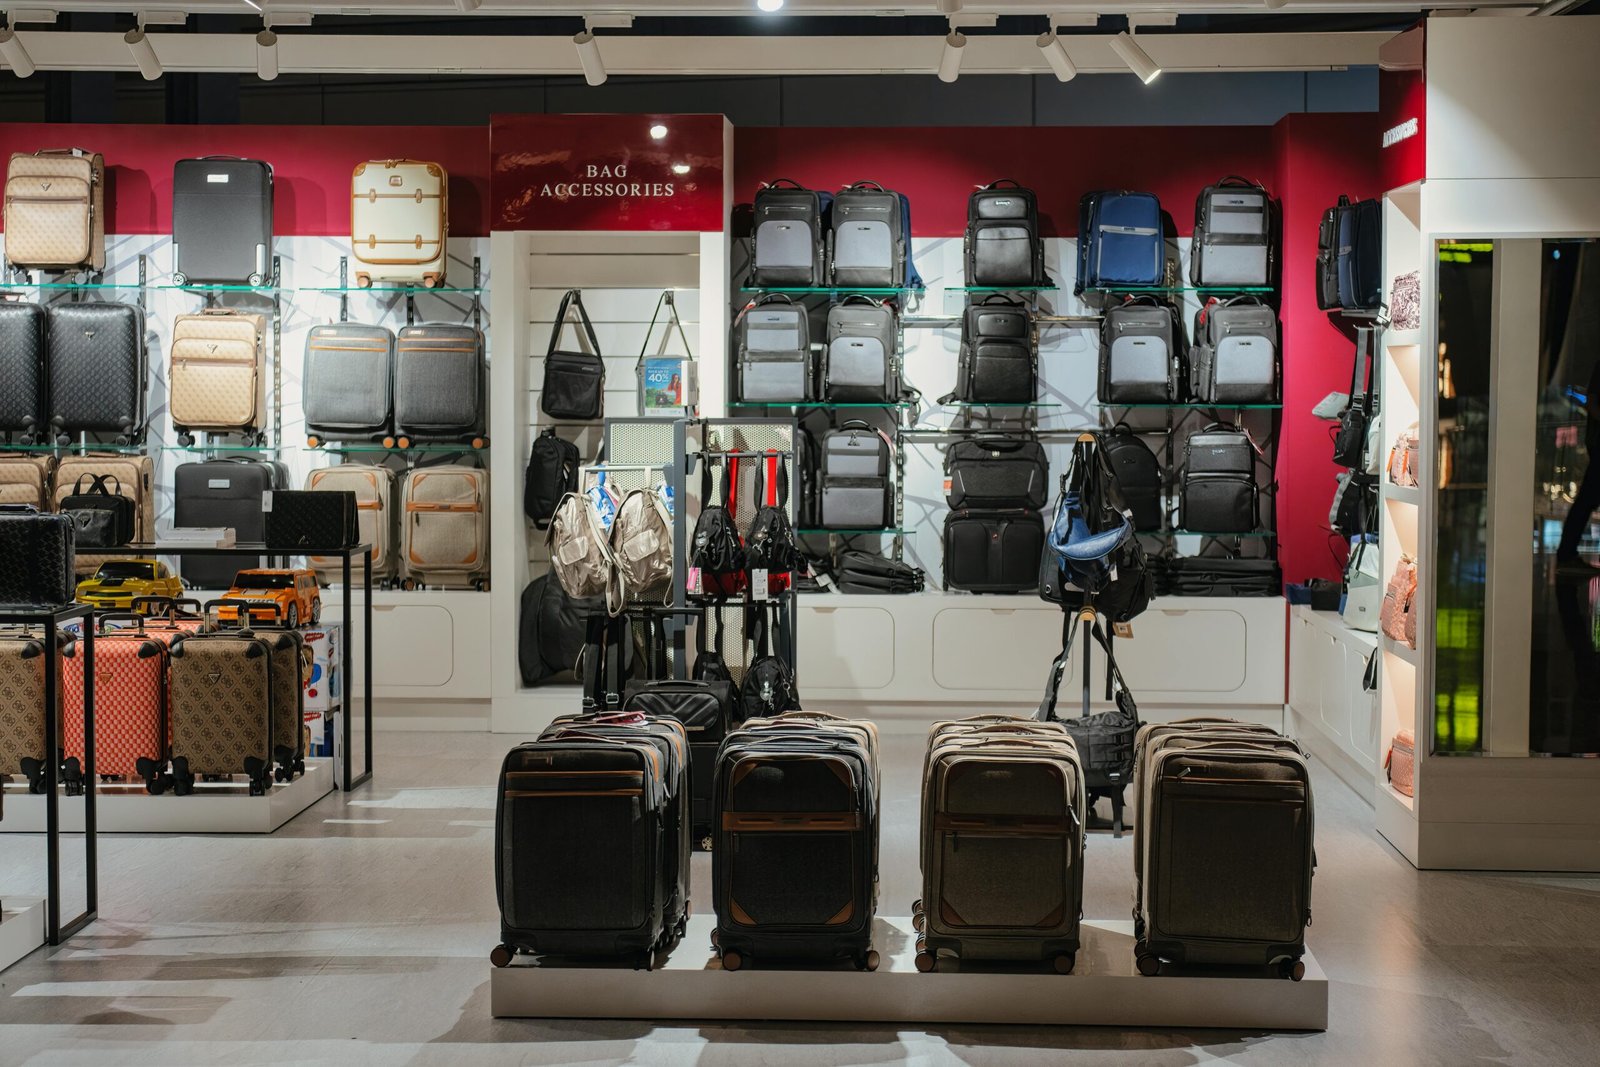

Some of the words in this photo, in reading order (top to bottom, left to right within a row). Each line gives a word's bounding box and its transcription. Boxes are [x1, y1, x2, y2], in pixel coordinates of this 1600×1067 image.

[587, 164, 627, 178] BAG
[540, 183, 674, 197] ACCESSORIES
[648, 373, 669, 383] 40%
